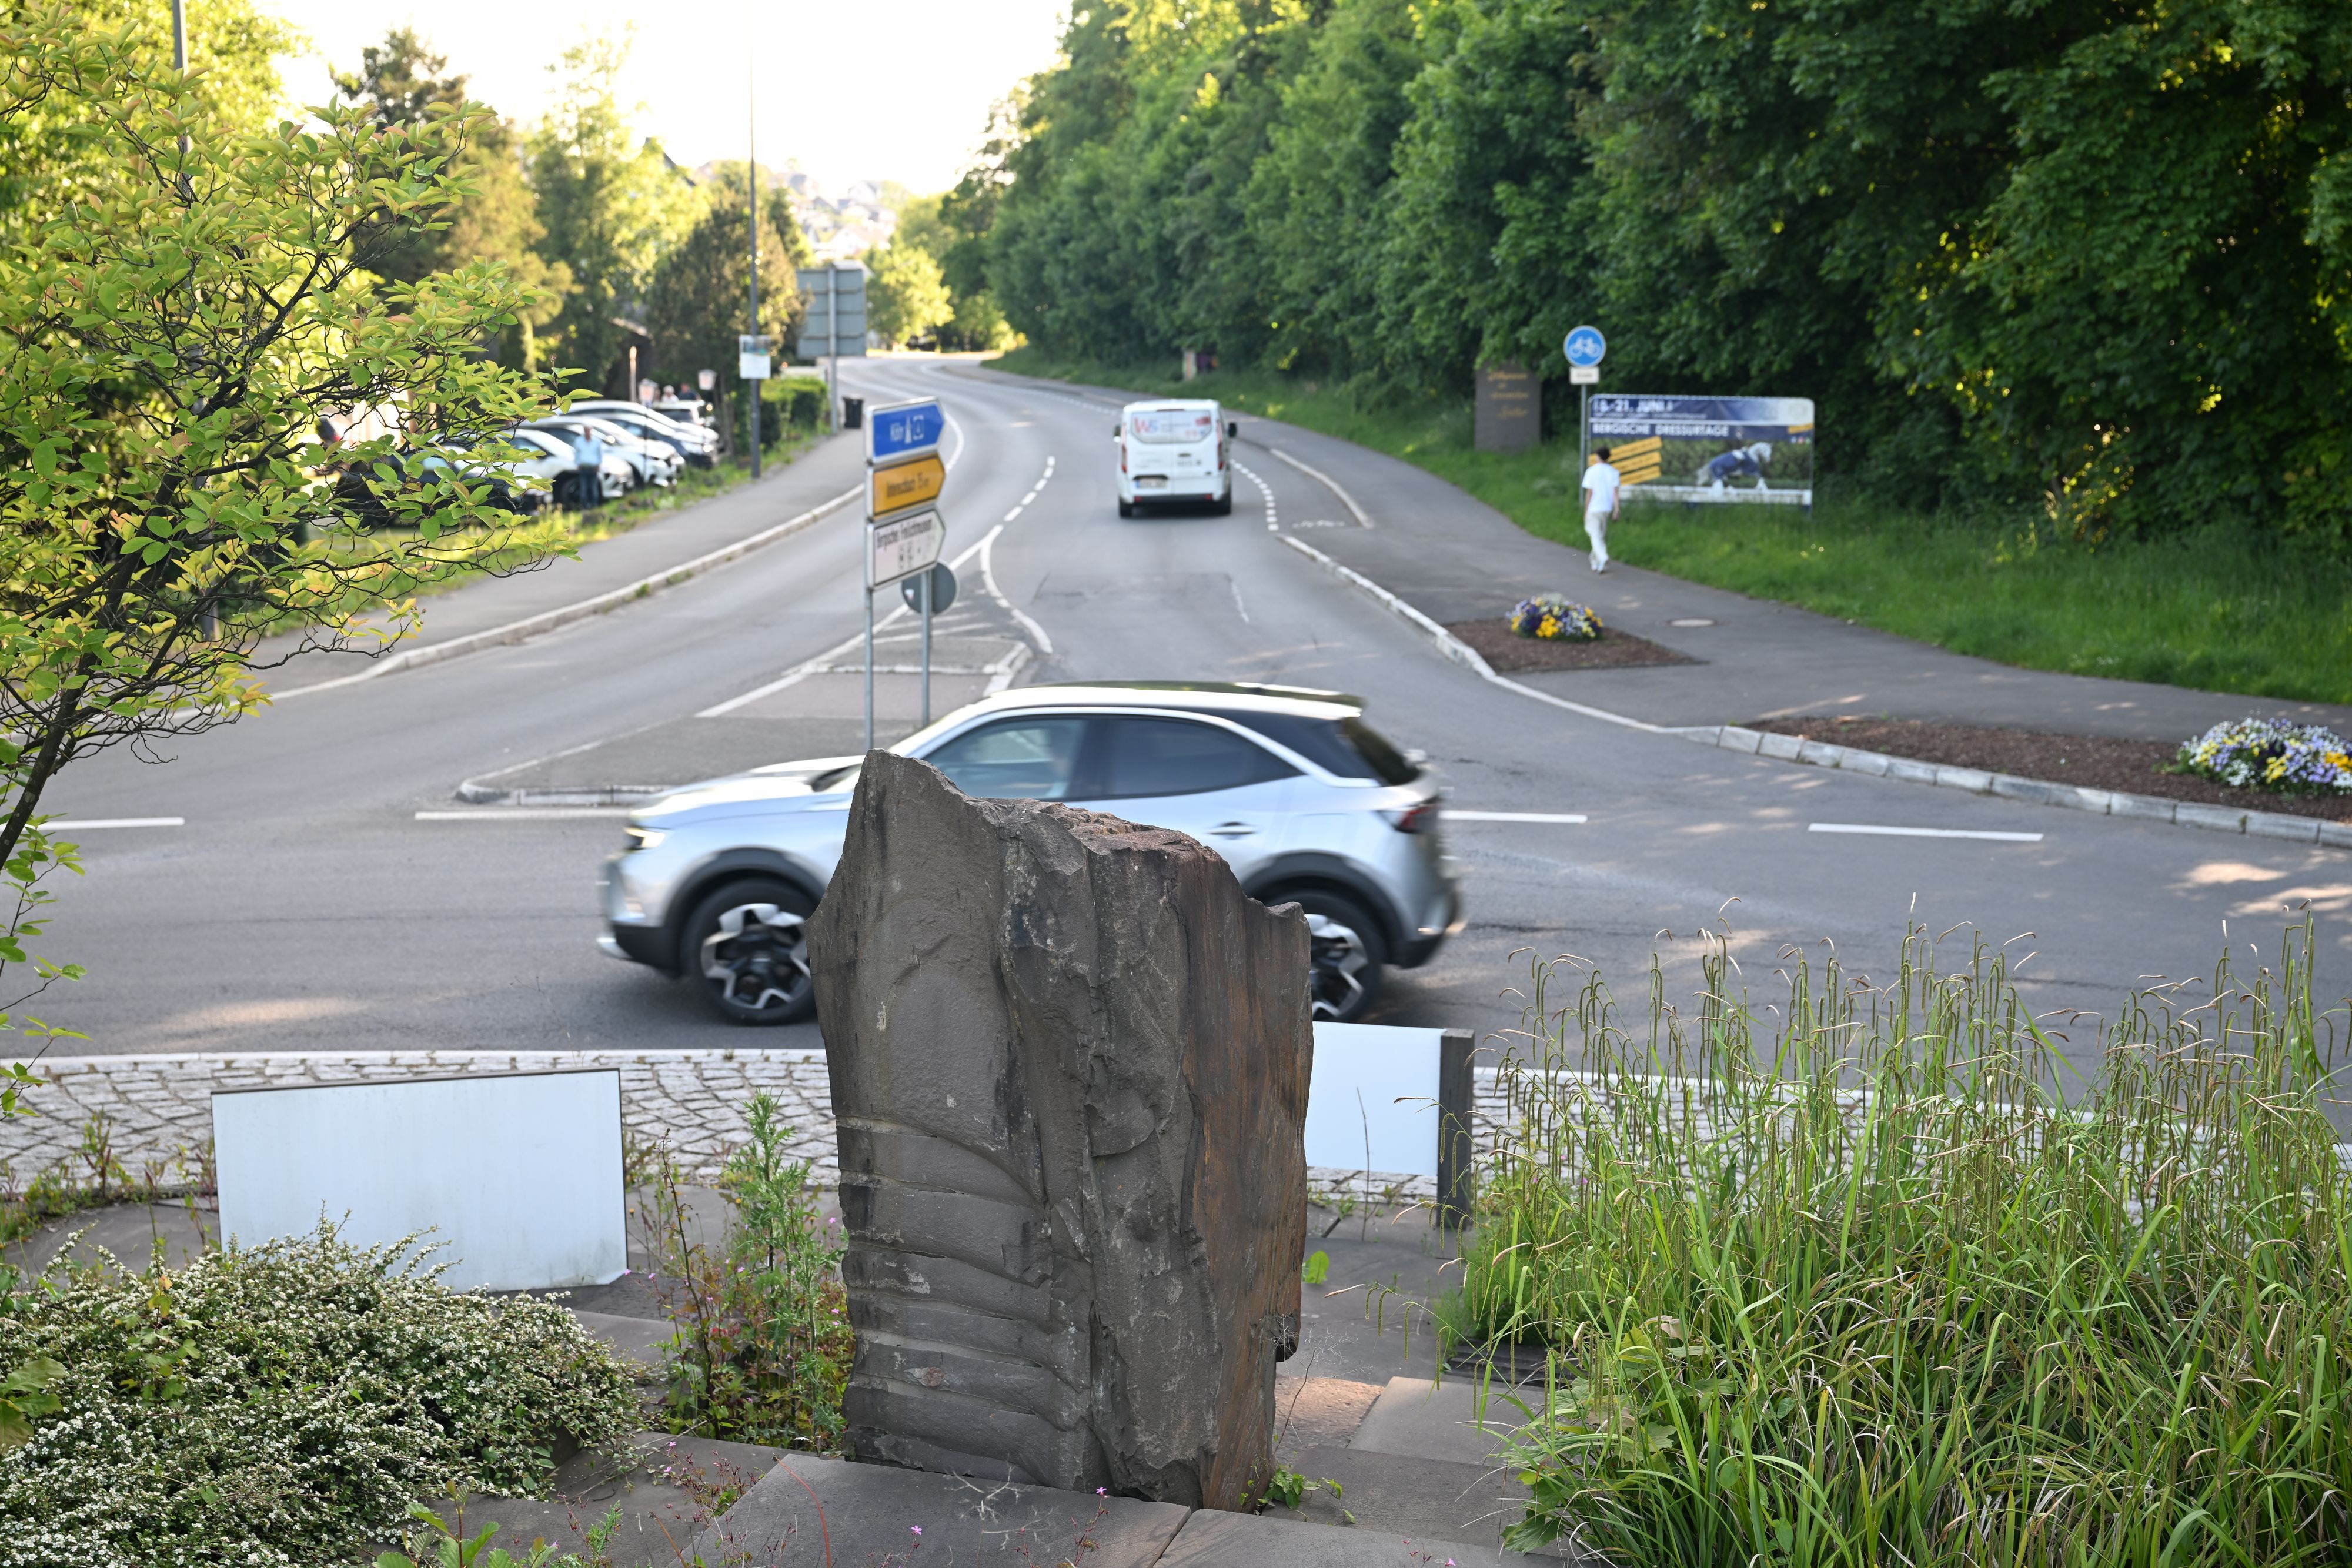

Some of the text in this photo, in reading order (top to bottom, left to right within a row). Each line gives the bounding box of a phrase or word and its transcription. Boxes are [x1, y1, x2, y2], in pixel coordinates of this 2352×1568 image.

[1636, 400, 1665, 412] JUNI
[1592, 424, 1729, 436] BERGISCHE DRESSURTAGE
